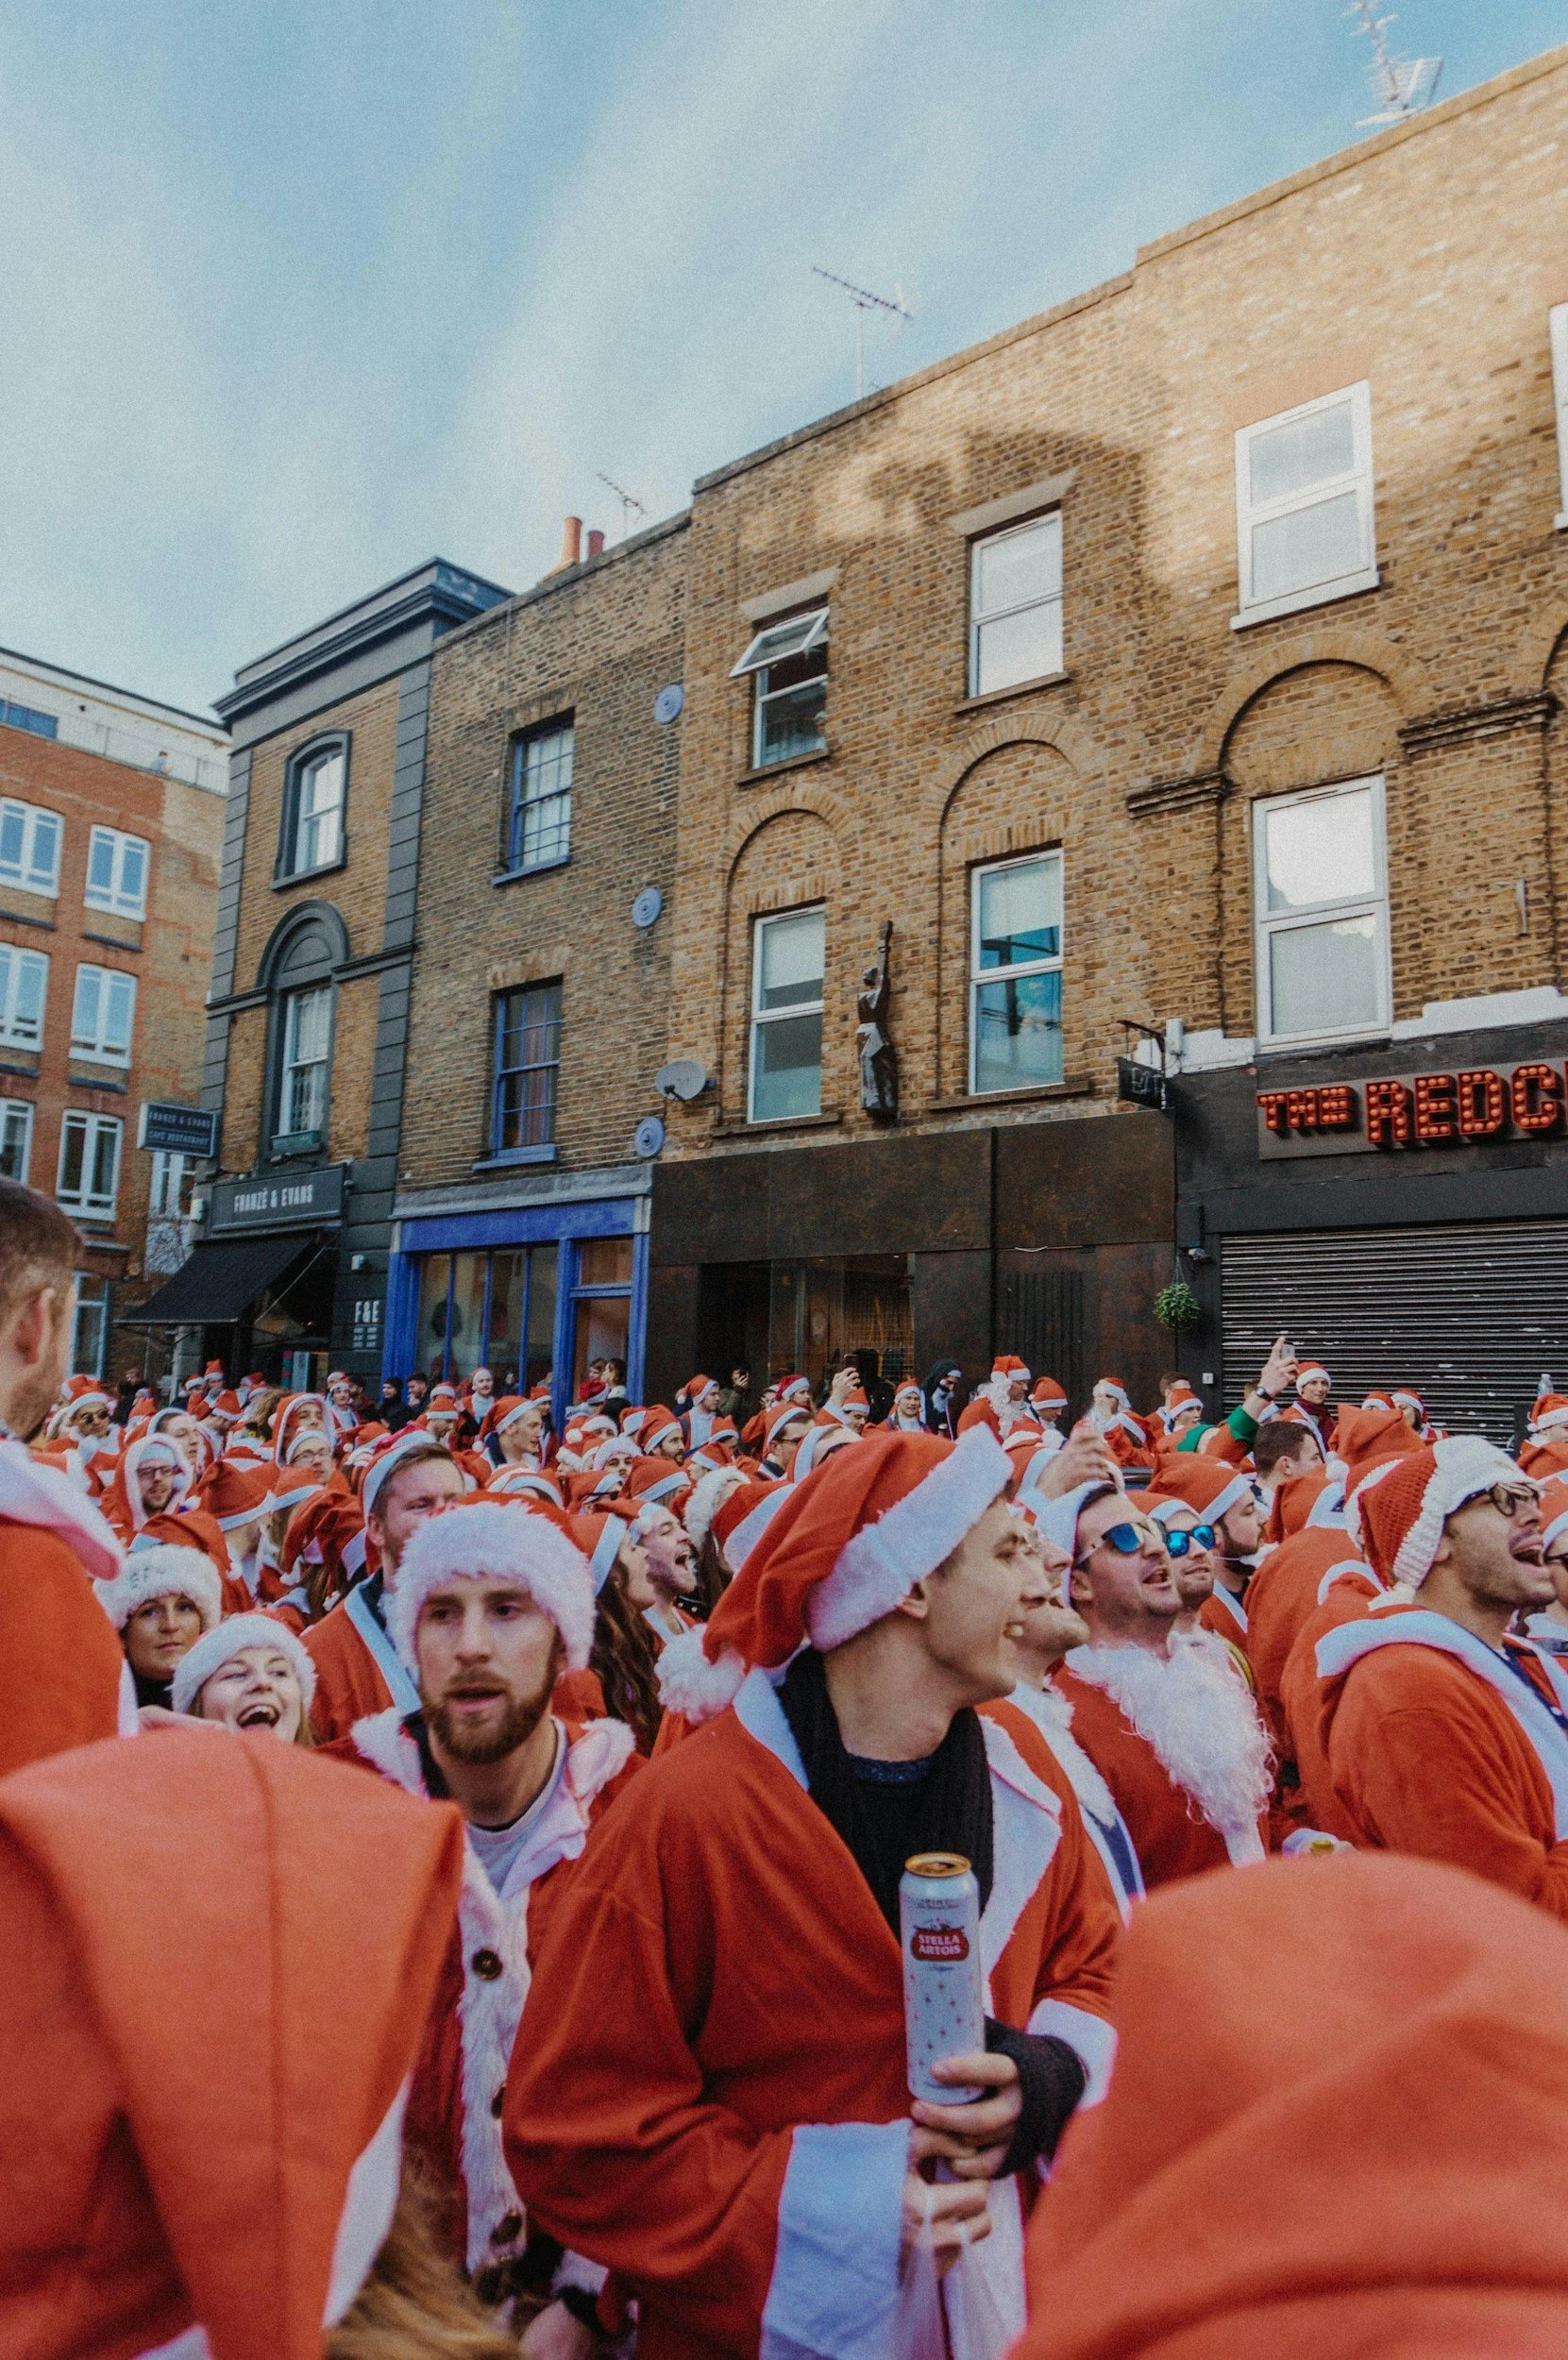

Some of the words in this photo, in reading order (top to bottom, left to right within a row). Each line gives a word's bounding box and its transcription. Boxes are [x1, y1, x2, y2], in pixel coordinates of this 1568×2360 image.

[1256, 1086, 1351, 1130] THE
[1365, 1059, 1568, 1143] REDC
[270, 1189, 278, 1208] &
[281, 1184, 313, 1207] EVANS
[354, 1300, 379, 1323] F&E
[919, 1934, 961, 1946] STELLA
[919, 1945, 962, 1956] ARTOIS
